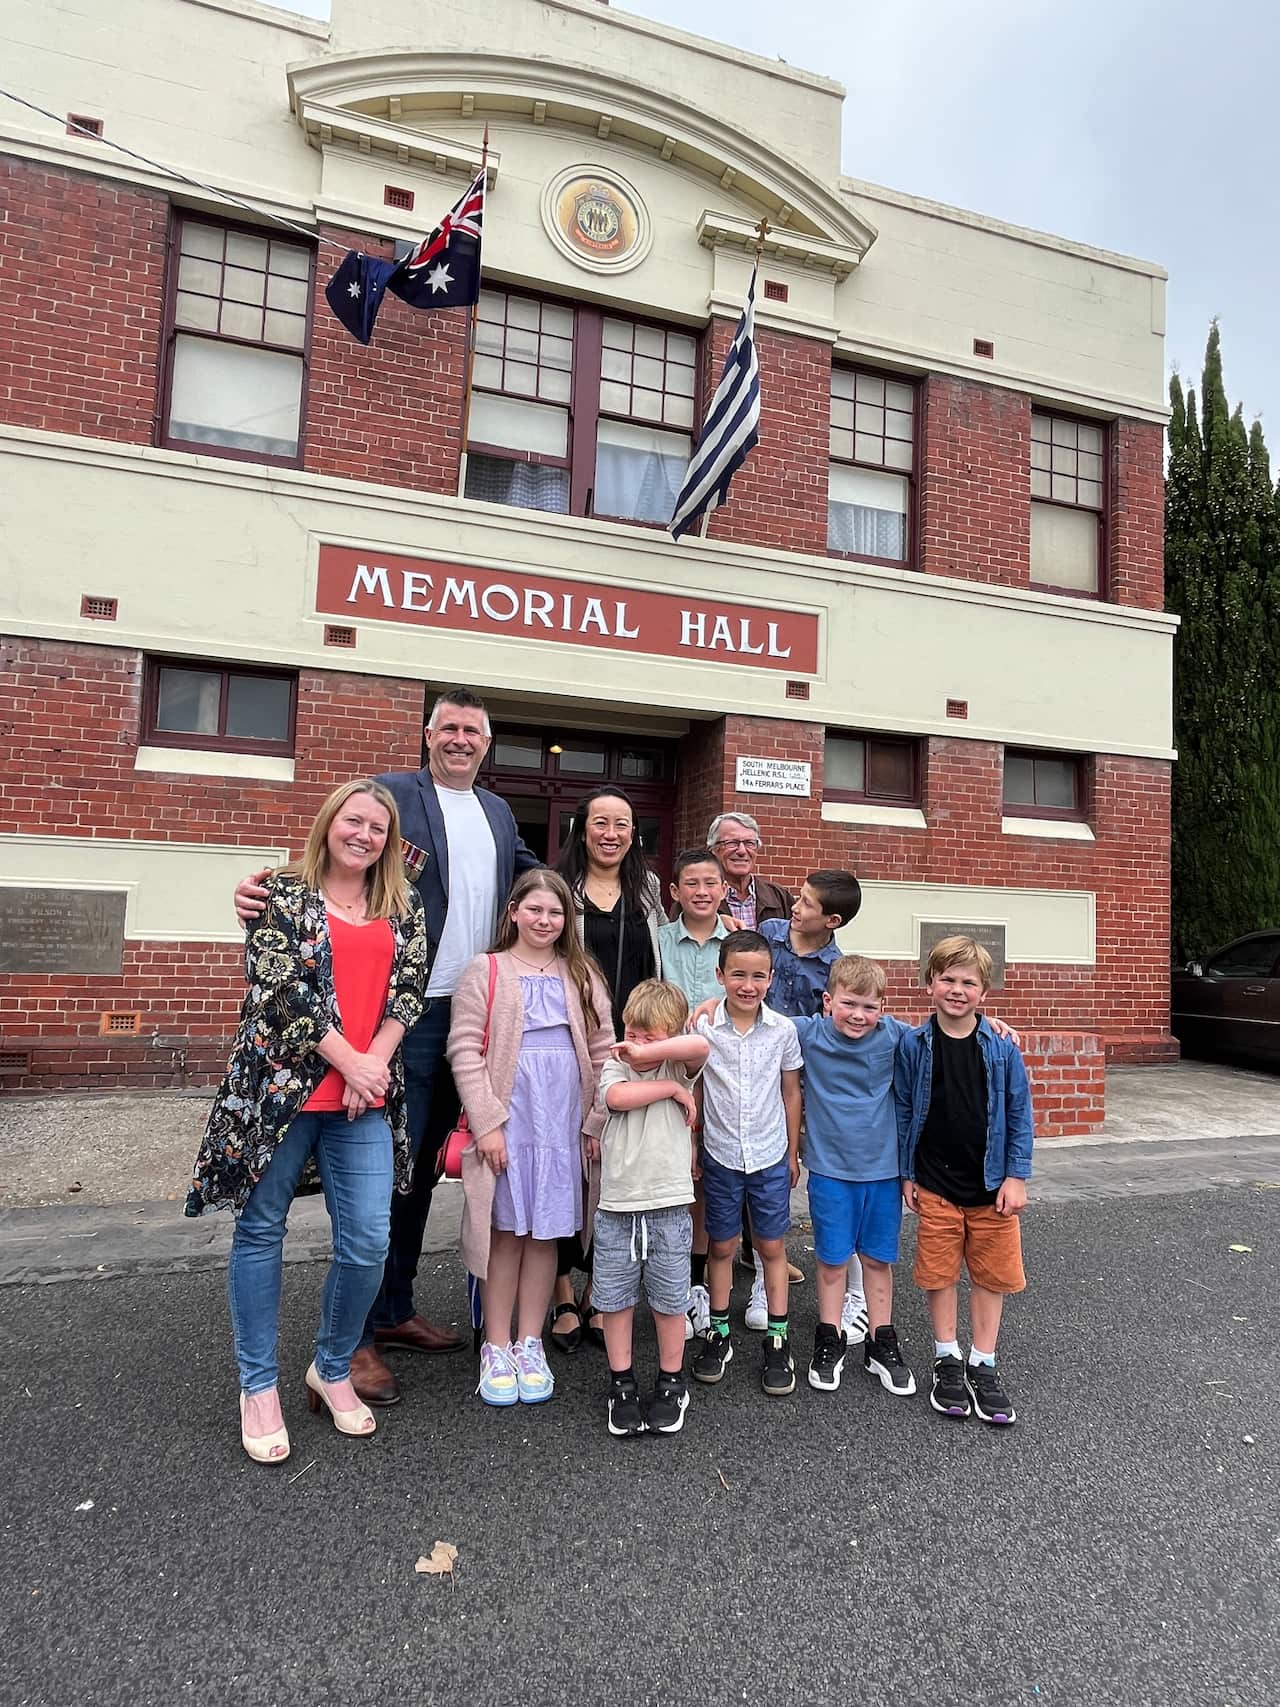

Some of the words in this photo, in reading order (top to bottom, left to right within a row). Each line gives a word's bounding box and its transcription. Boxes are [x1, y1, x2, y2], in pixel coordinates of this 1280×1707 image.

[346, 564, 640, 639] MEMORIAL
[679, 610, 792, 658] HALL
[767, 762, 806, 772] MELBOURNE
[742, 769, 770, 777] HELLENIC
[755, 780, 783, 789] FERRARS
[785, 782, 805, 791] PLACE
